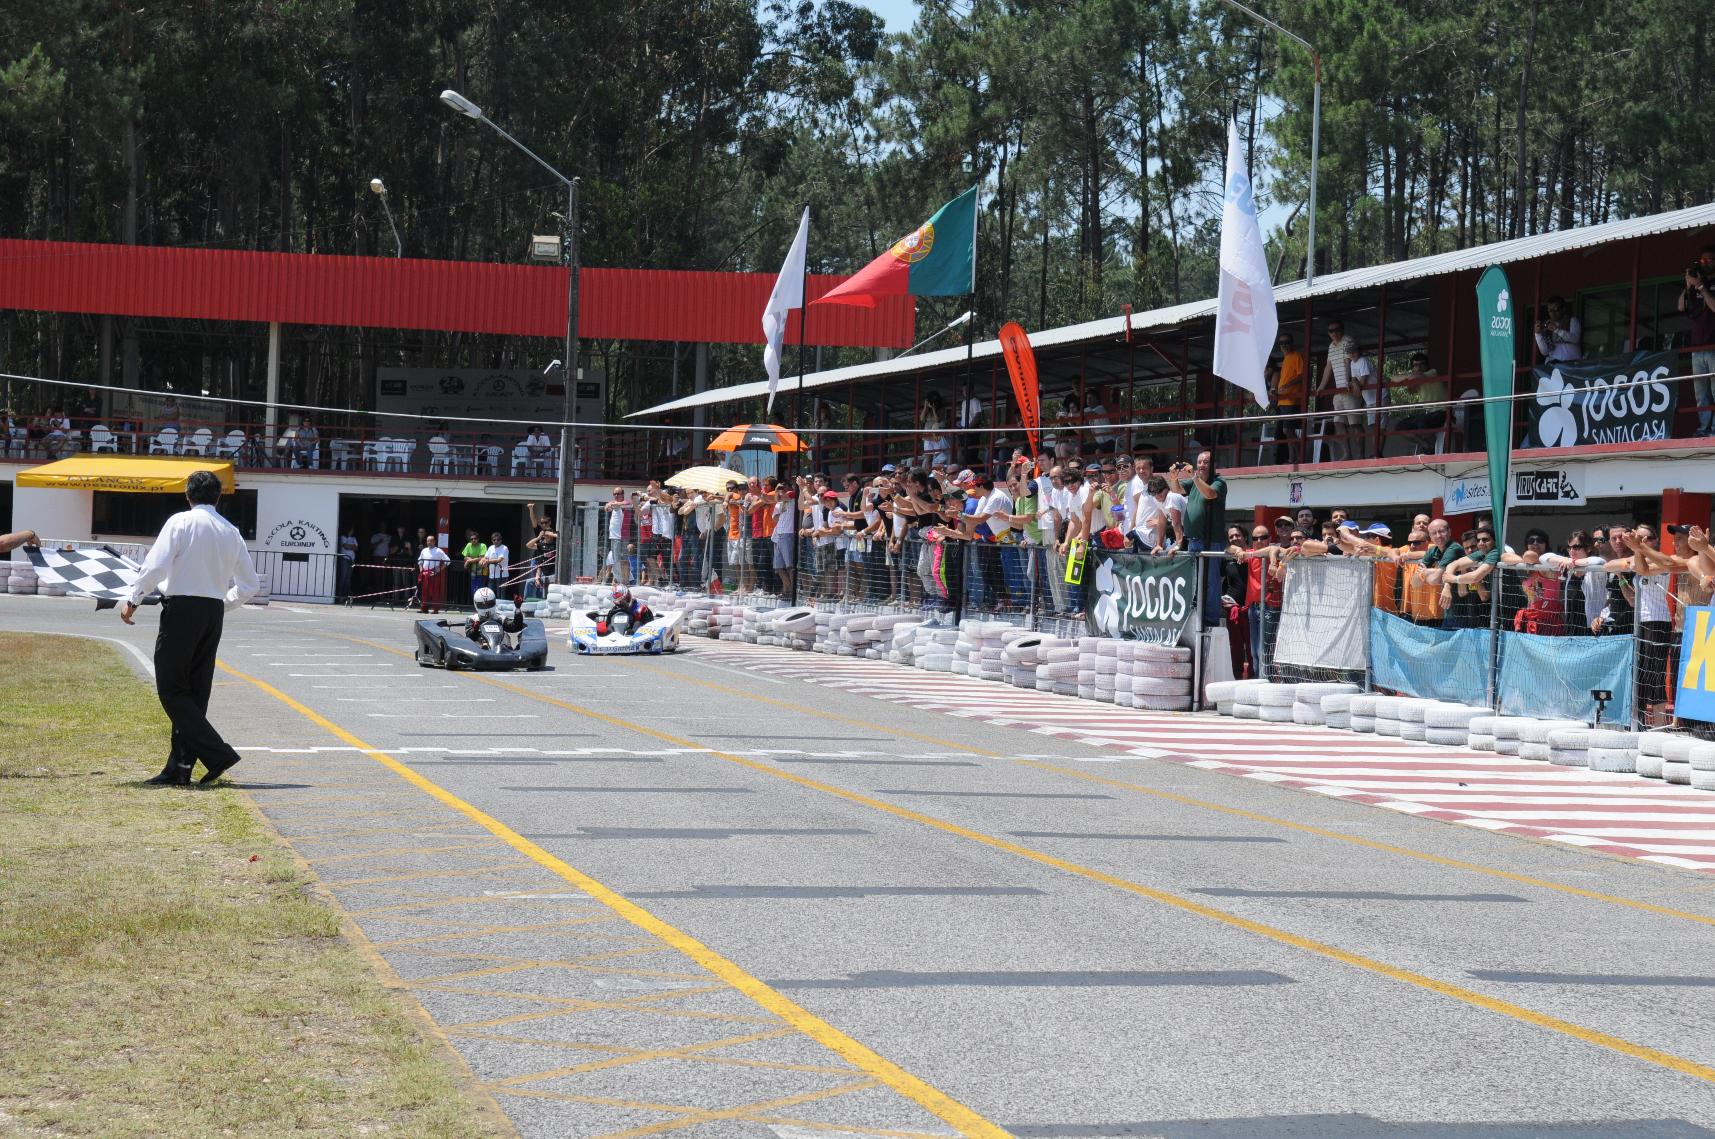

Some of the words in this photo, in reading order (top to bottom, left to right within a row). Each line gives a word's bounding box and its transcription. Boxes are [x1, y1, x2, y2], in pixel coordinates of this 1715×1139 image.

[1582, 366, 1671, 439] JOGOS
[1592, 419, 1666, 445] SANTACASA
[1516, 474, 1535, 497] VIRUS
[265, 520, 293, 546] ESCOLA
[299, 520, 330, 548] KARTING
[280, 540, 316, 548] EUROINDY
[1122, 575, 1186, 632] JOGOS
